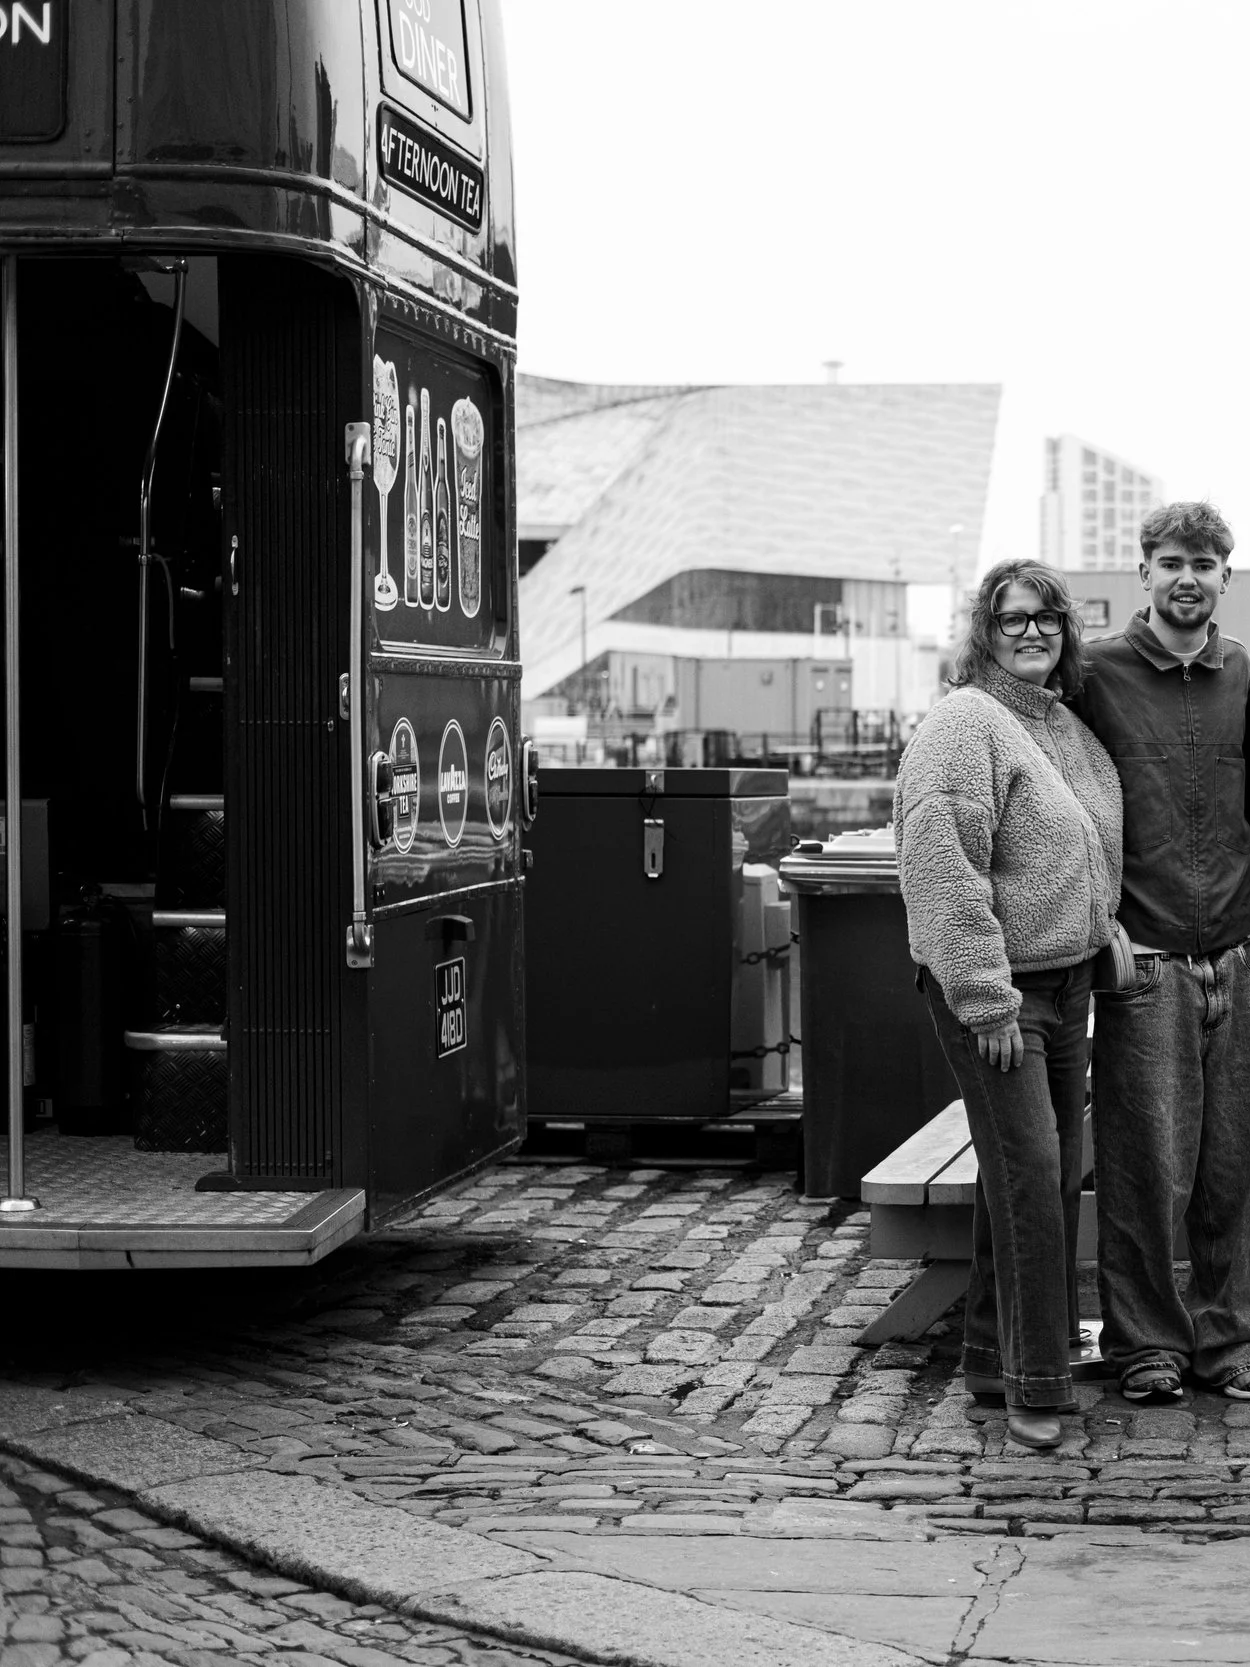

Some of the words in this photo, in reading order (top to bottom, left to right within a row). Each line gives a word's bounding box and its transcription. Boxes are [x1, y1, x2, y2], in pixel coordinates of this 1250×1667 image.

[0, 2, 51, 44] N
[399, 9, 461, 107] DINER
[381, 123, 459, 205] AFTERNOON
[461, 173, 480, 219] TEA
[391, 773, 417, 796] ORKSHIRE
[440, 764, 466, 793] LAVAZZA
[399, 795, 410, 814] TEA
[441, 966, 461, 1006] JJD
[441, 1007, 463, 1049] 418D
